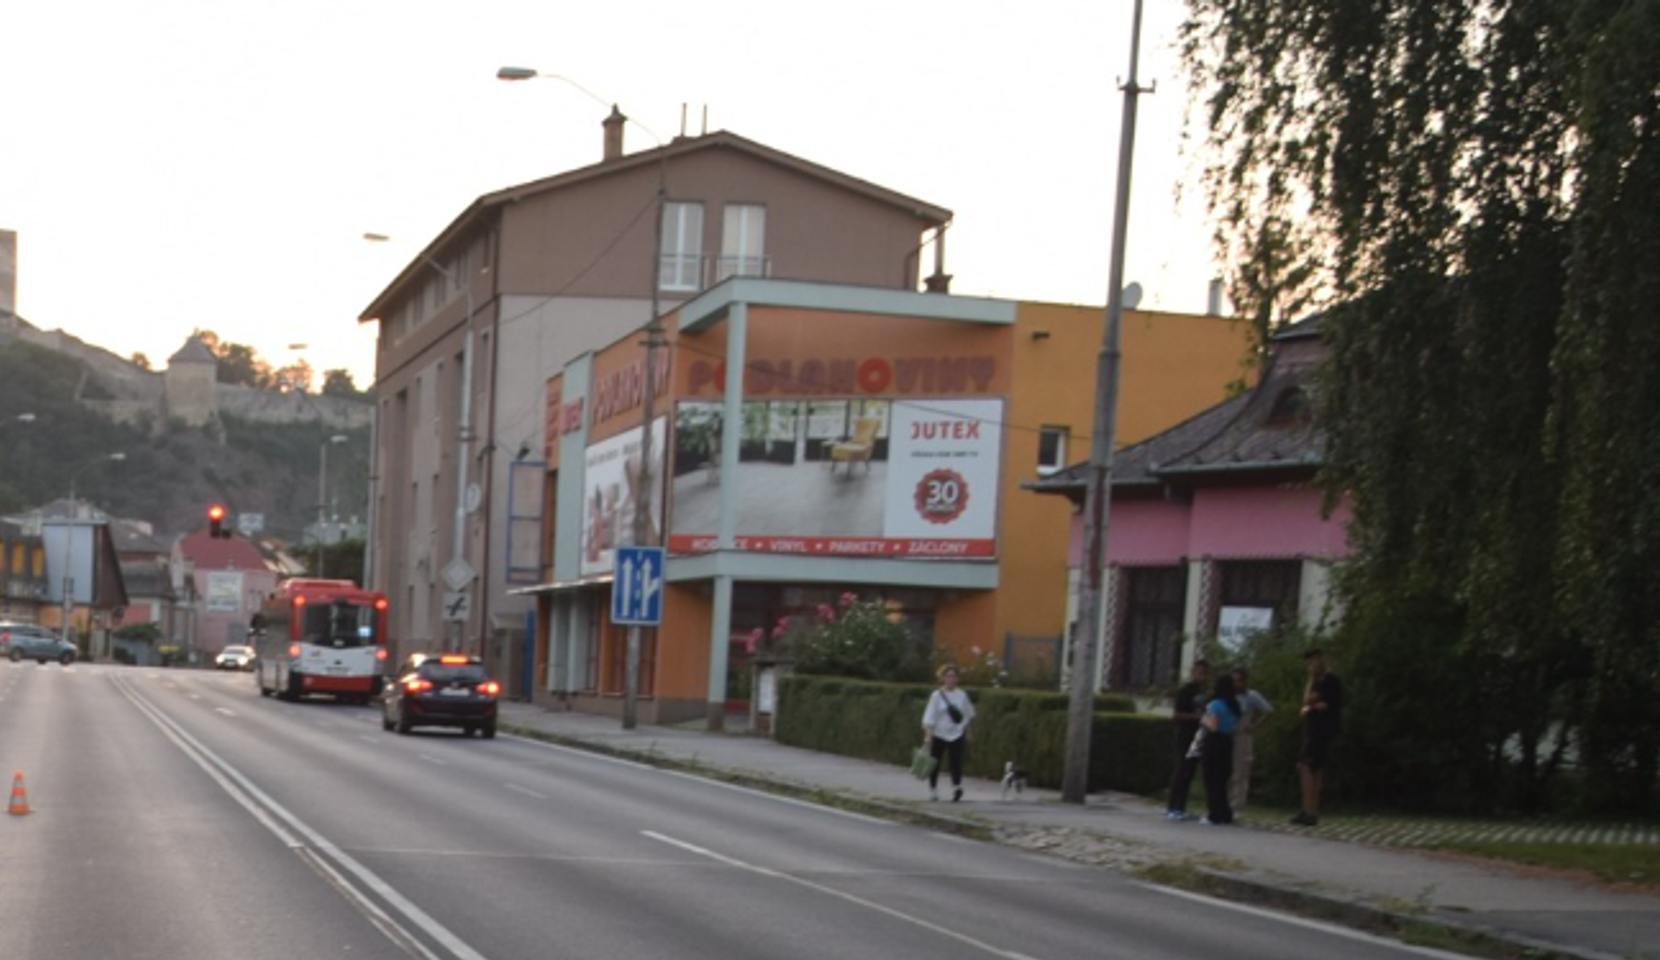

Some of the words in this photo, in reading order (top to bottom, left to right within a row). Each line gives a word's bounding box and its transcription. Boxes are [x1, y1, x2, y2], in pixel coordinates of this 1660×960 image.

[909, 419, 980, 441] JUTEX
[925, 481, 959, 505] 30
[769, 540, 808, 553] VINYL
